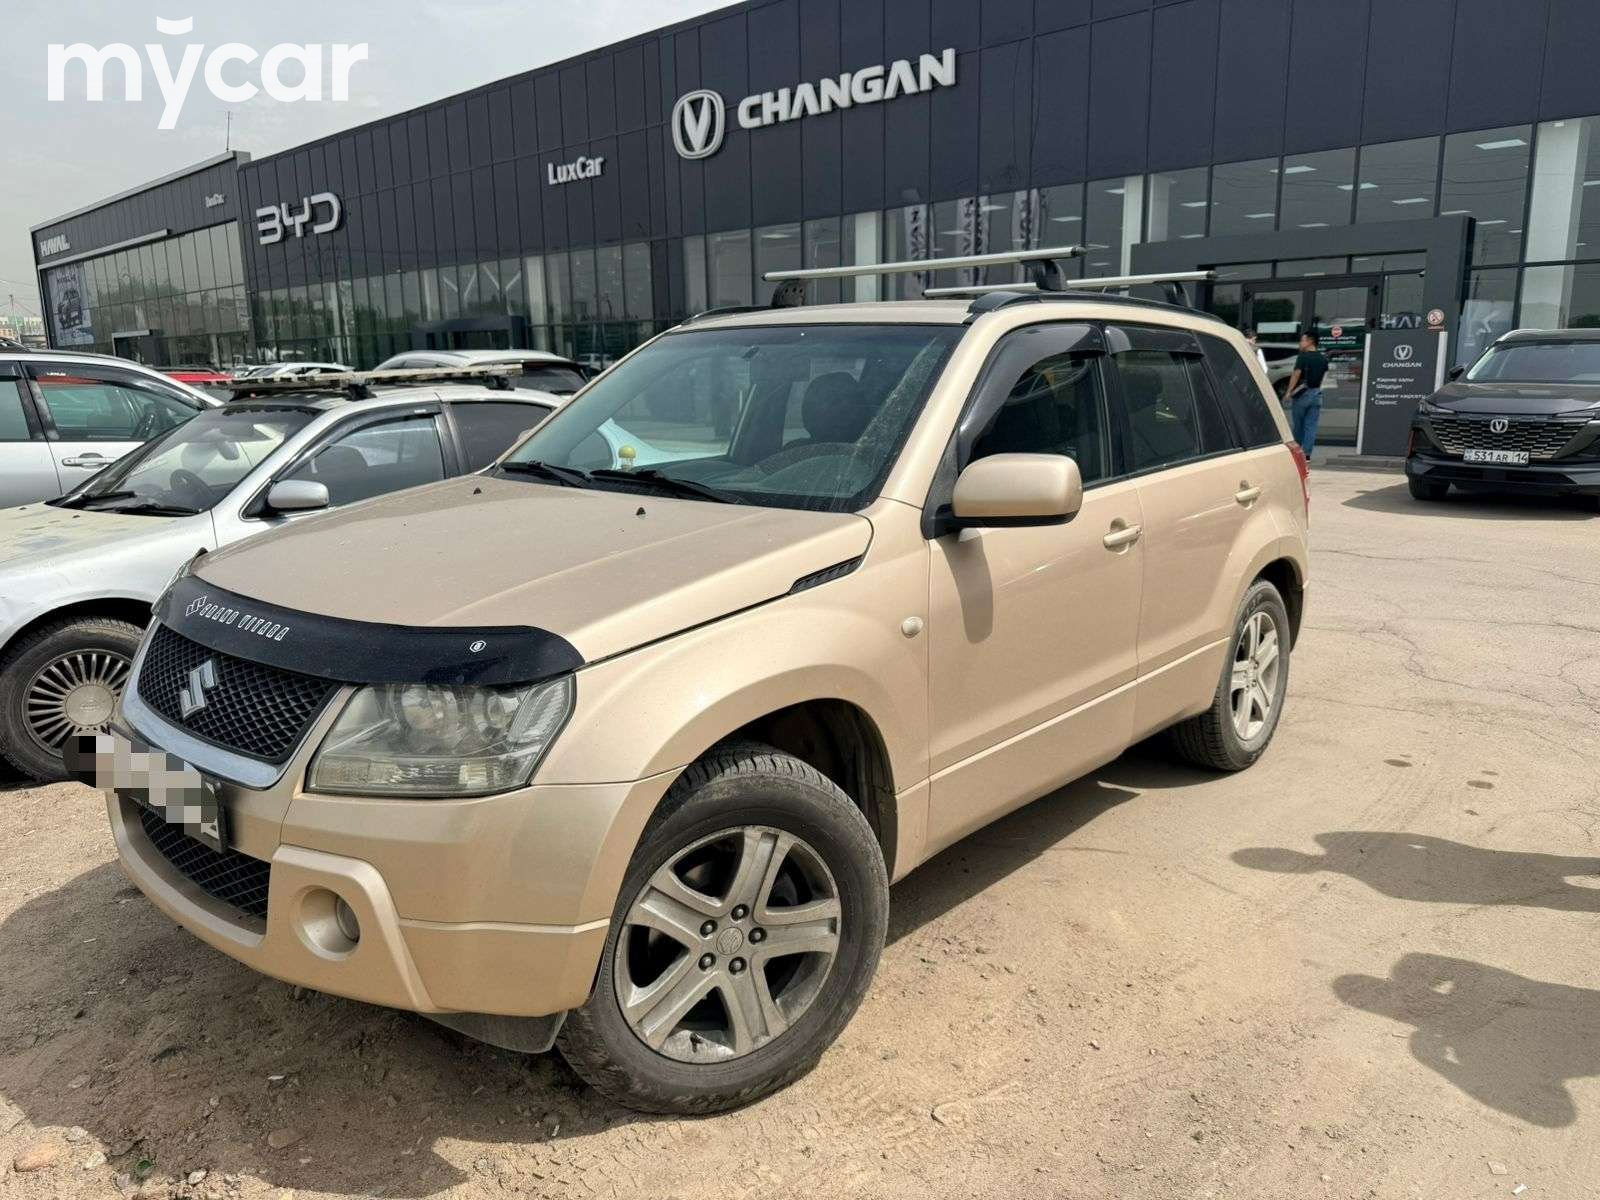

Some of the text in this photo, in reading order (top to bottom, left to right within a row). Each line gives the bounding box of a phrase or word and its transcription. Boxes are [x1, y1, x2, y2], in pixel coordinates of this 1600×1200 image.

[737, 48, 956, 130] CHANGAN
[547, 156, 605, 186] LuxCar
[256, 192, 342, 246] BYD
[1474, 450, 1529, 465] 531 AR 14
